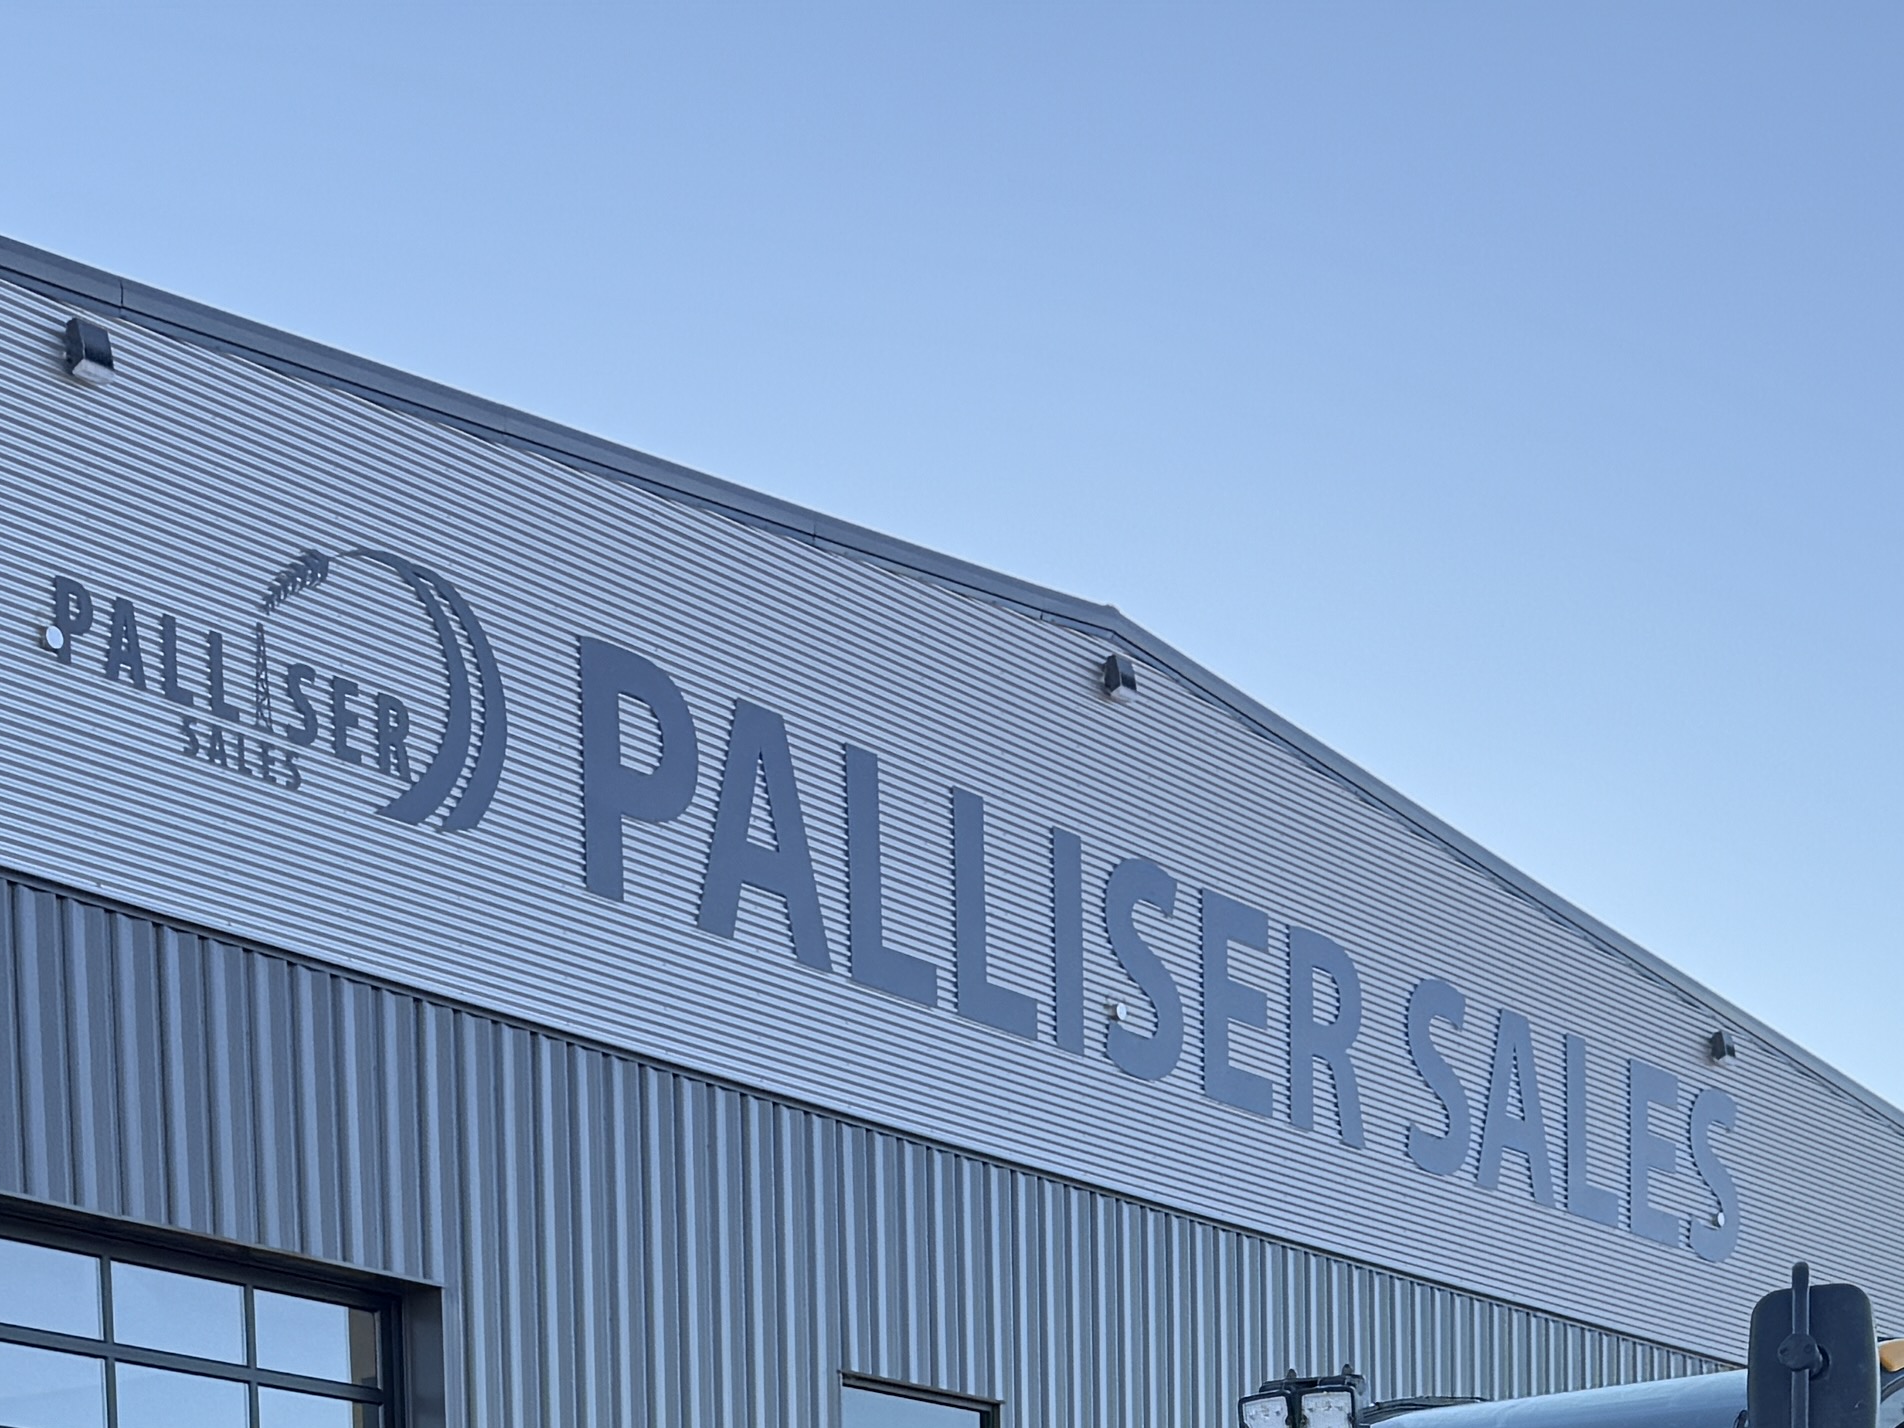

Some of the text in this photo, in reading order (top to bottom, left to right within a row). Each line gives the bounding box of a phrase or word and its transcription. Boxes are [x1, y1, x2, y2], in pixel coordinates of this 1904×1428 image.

[53, 575, 413, 785] PALLISER
[182, 714, 302, 791] SALES
[576, 635, 1741, 1263] PALLISER SALES
